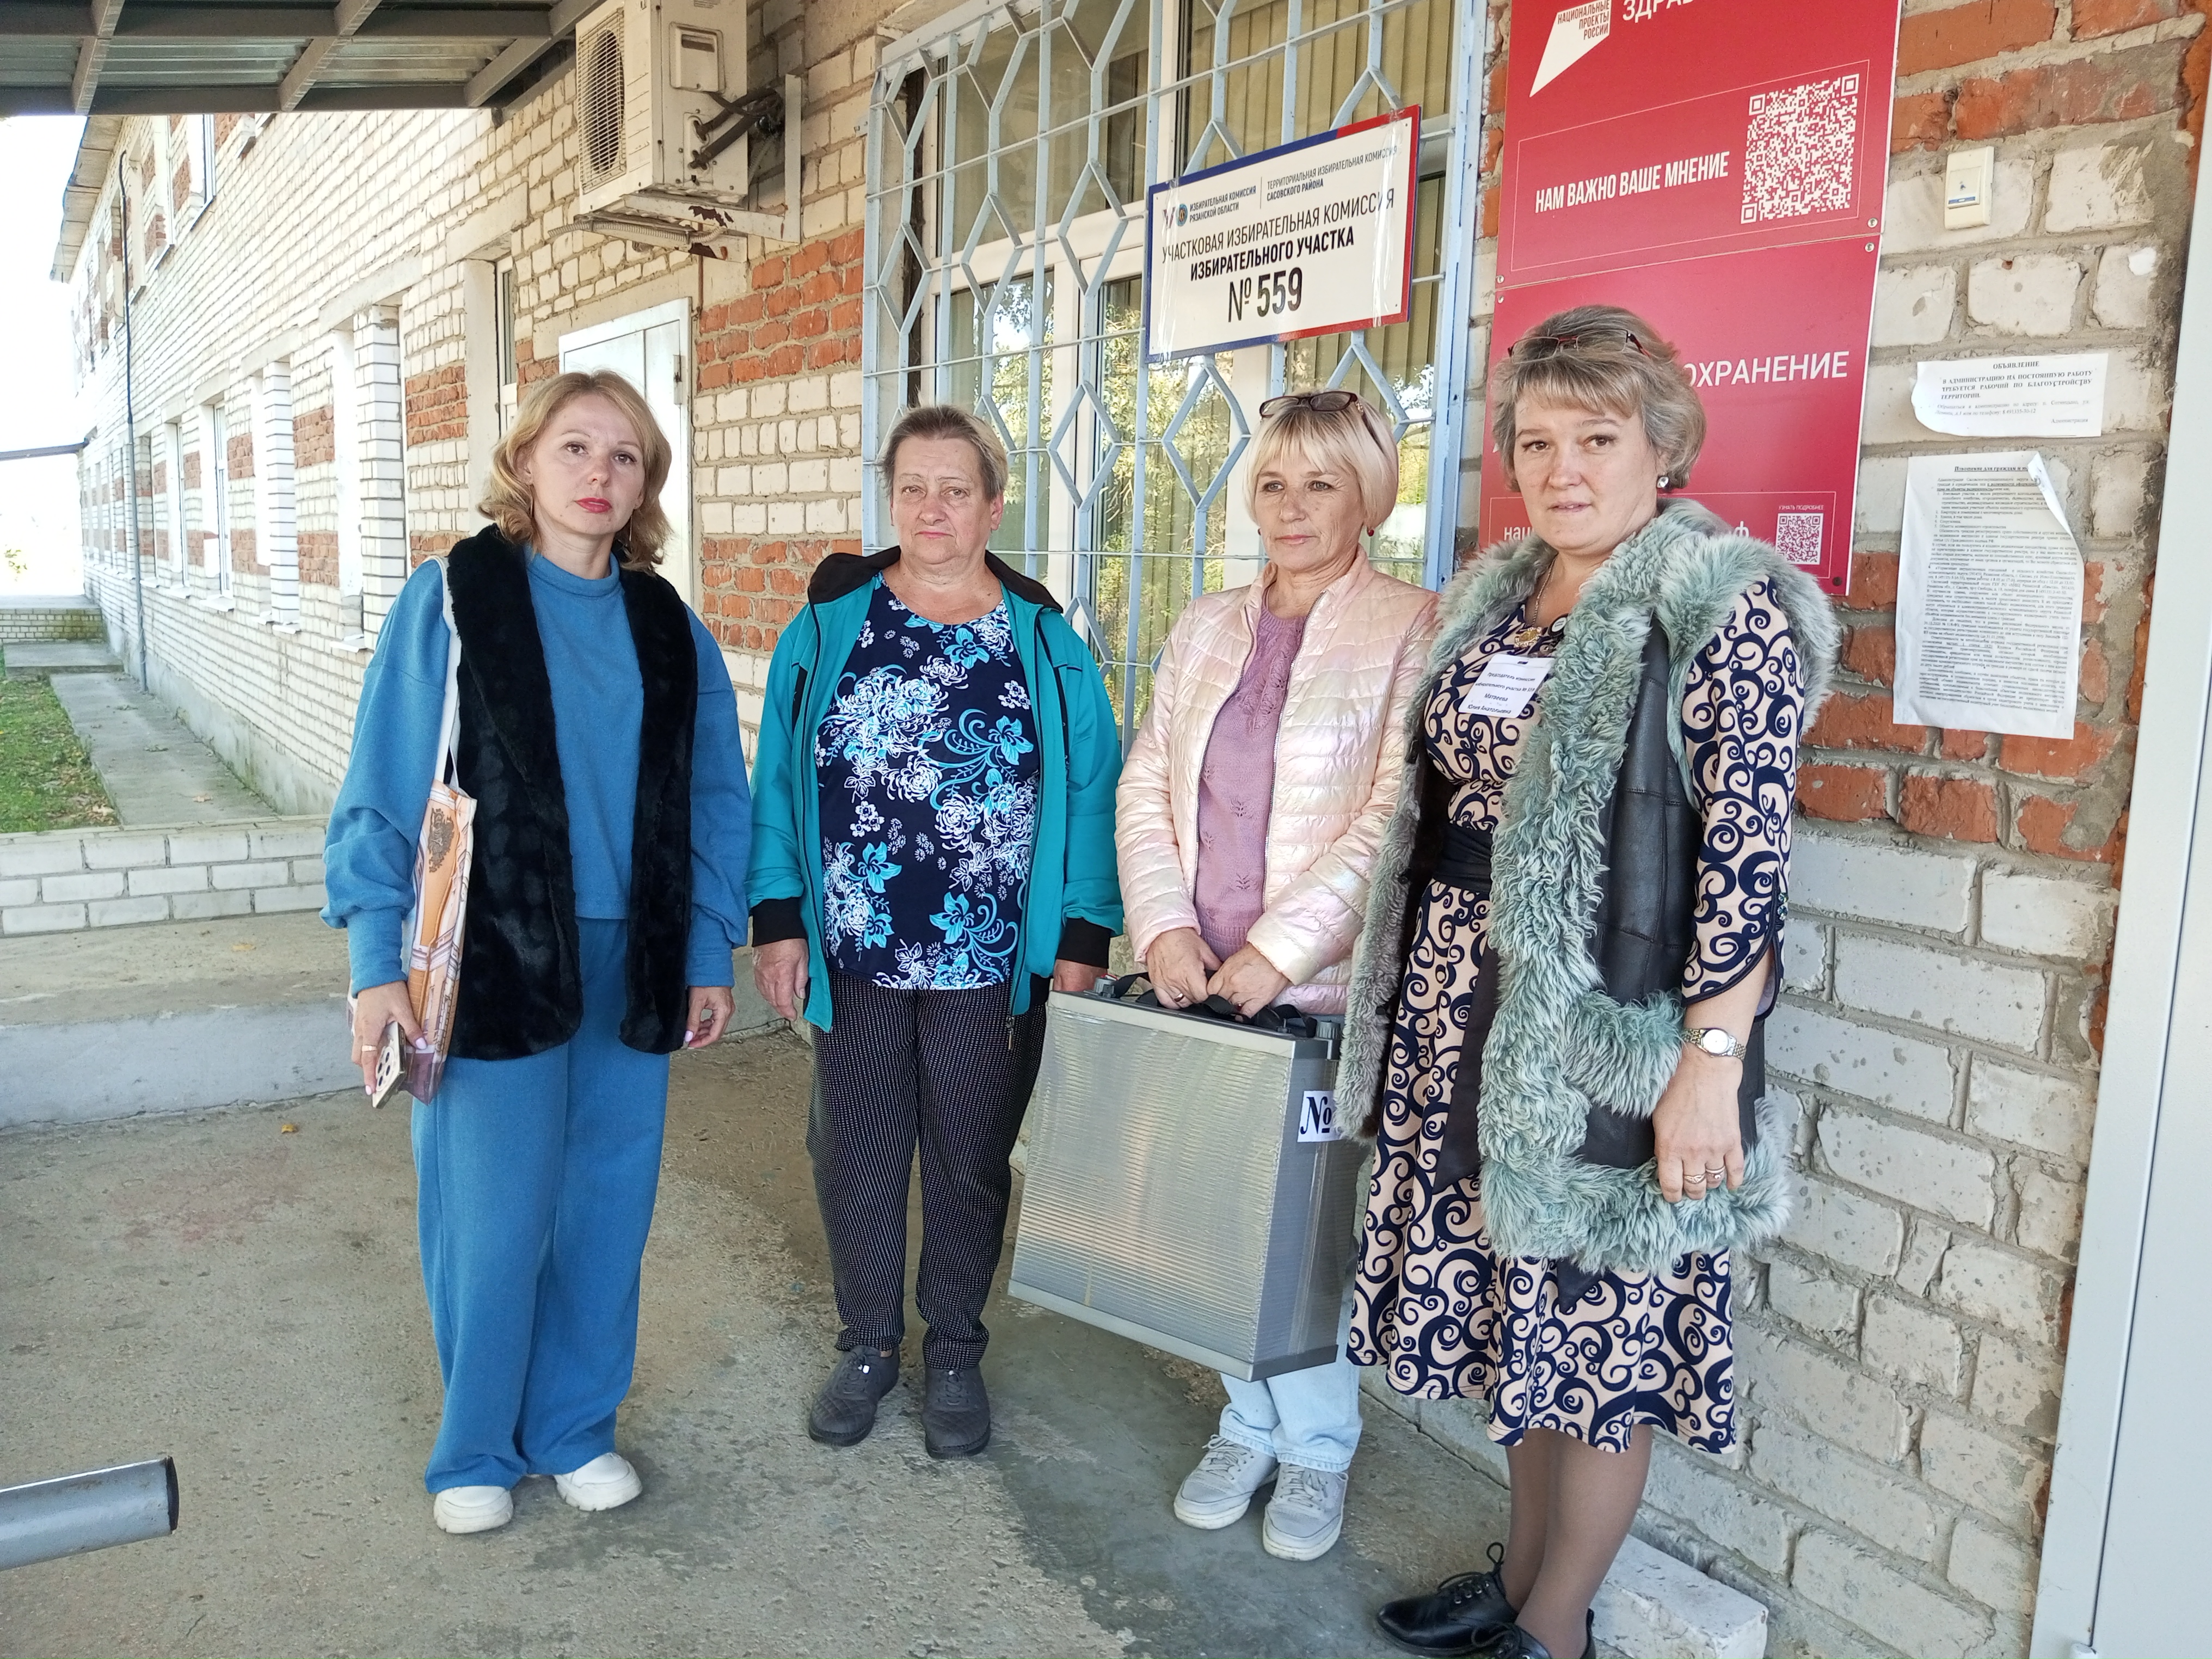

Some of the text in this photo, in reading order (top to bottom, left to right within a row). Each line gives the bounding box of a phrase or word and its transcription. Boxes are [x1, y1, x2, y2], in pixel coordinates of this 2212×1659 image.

[1557, 0, 1609, 24] НАЦИОНАЛЬНЫЕ
[1578, 11, 1609, 29] ПРОЕКТЫ
[1583, 23, 1608, 40] РОССИИ
[1267, 169, 1316, 190] ТЕРРИТОРИАЛЬНАЯ
[1317, 155, 1363, 176] ИЗБИРАТЕЛЬНАЯ
[1535, 151, 1730, 214] НАМ ВАЖНО ВАШЕ МНЕНИЕ
[1189, 186, 1256, 212] ИЗБИРАТЕЛЬНАЯ КОМИССИЯ
[1267, 178, 1324, 201] САСОВСКОГО РАЙОНА
[1189, 202, 1239, 223] РЯЗАНСКОЙ ОБЛАСТИ
[1162, 232, 1224, 264] УЧАСТКОВАЯ
[1226, 207, 1320, 248] ИЗБИРАТЕЛЬНАЯ
[1190, 226, 1354, 281] ИЗБИРАТЕЛЬНОГО УЧАСТКА
[1228, 267, 1303, 323] № 559
[1993, 361, 2039, 370] ОБЪЯВЛЕНИЕ
[1949, 376, 2005, 384] АДМИНИСТРАЦИЮ
[2027, 379, 2093, 387] БЛАГОУСТРОЙСТВУ
